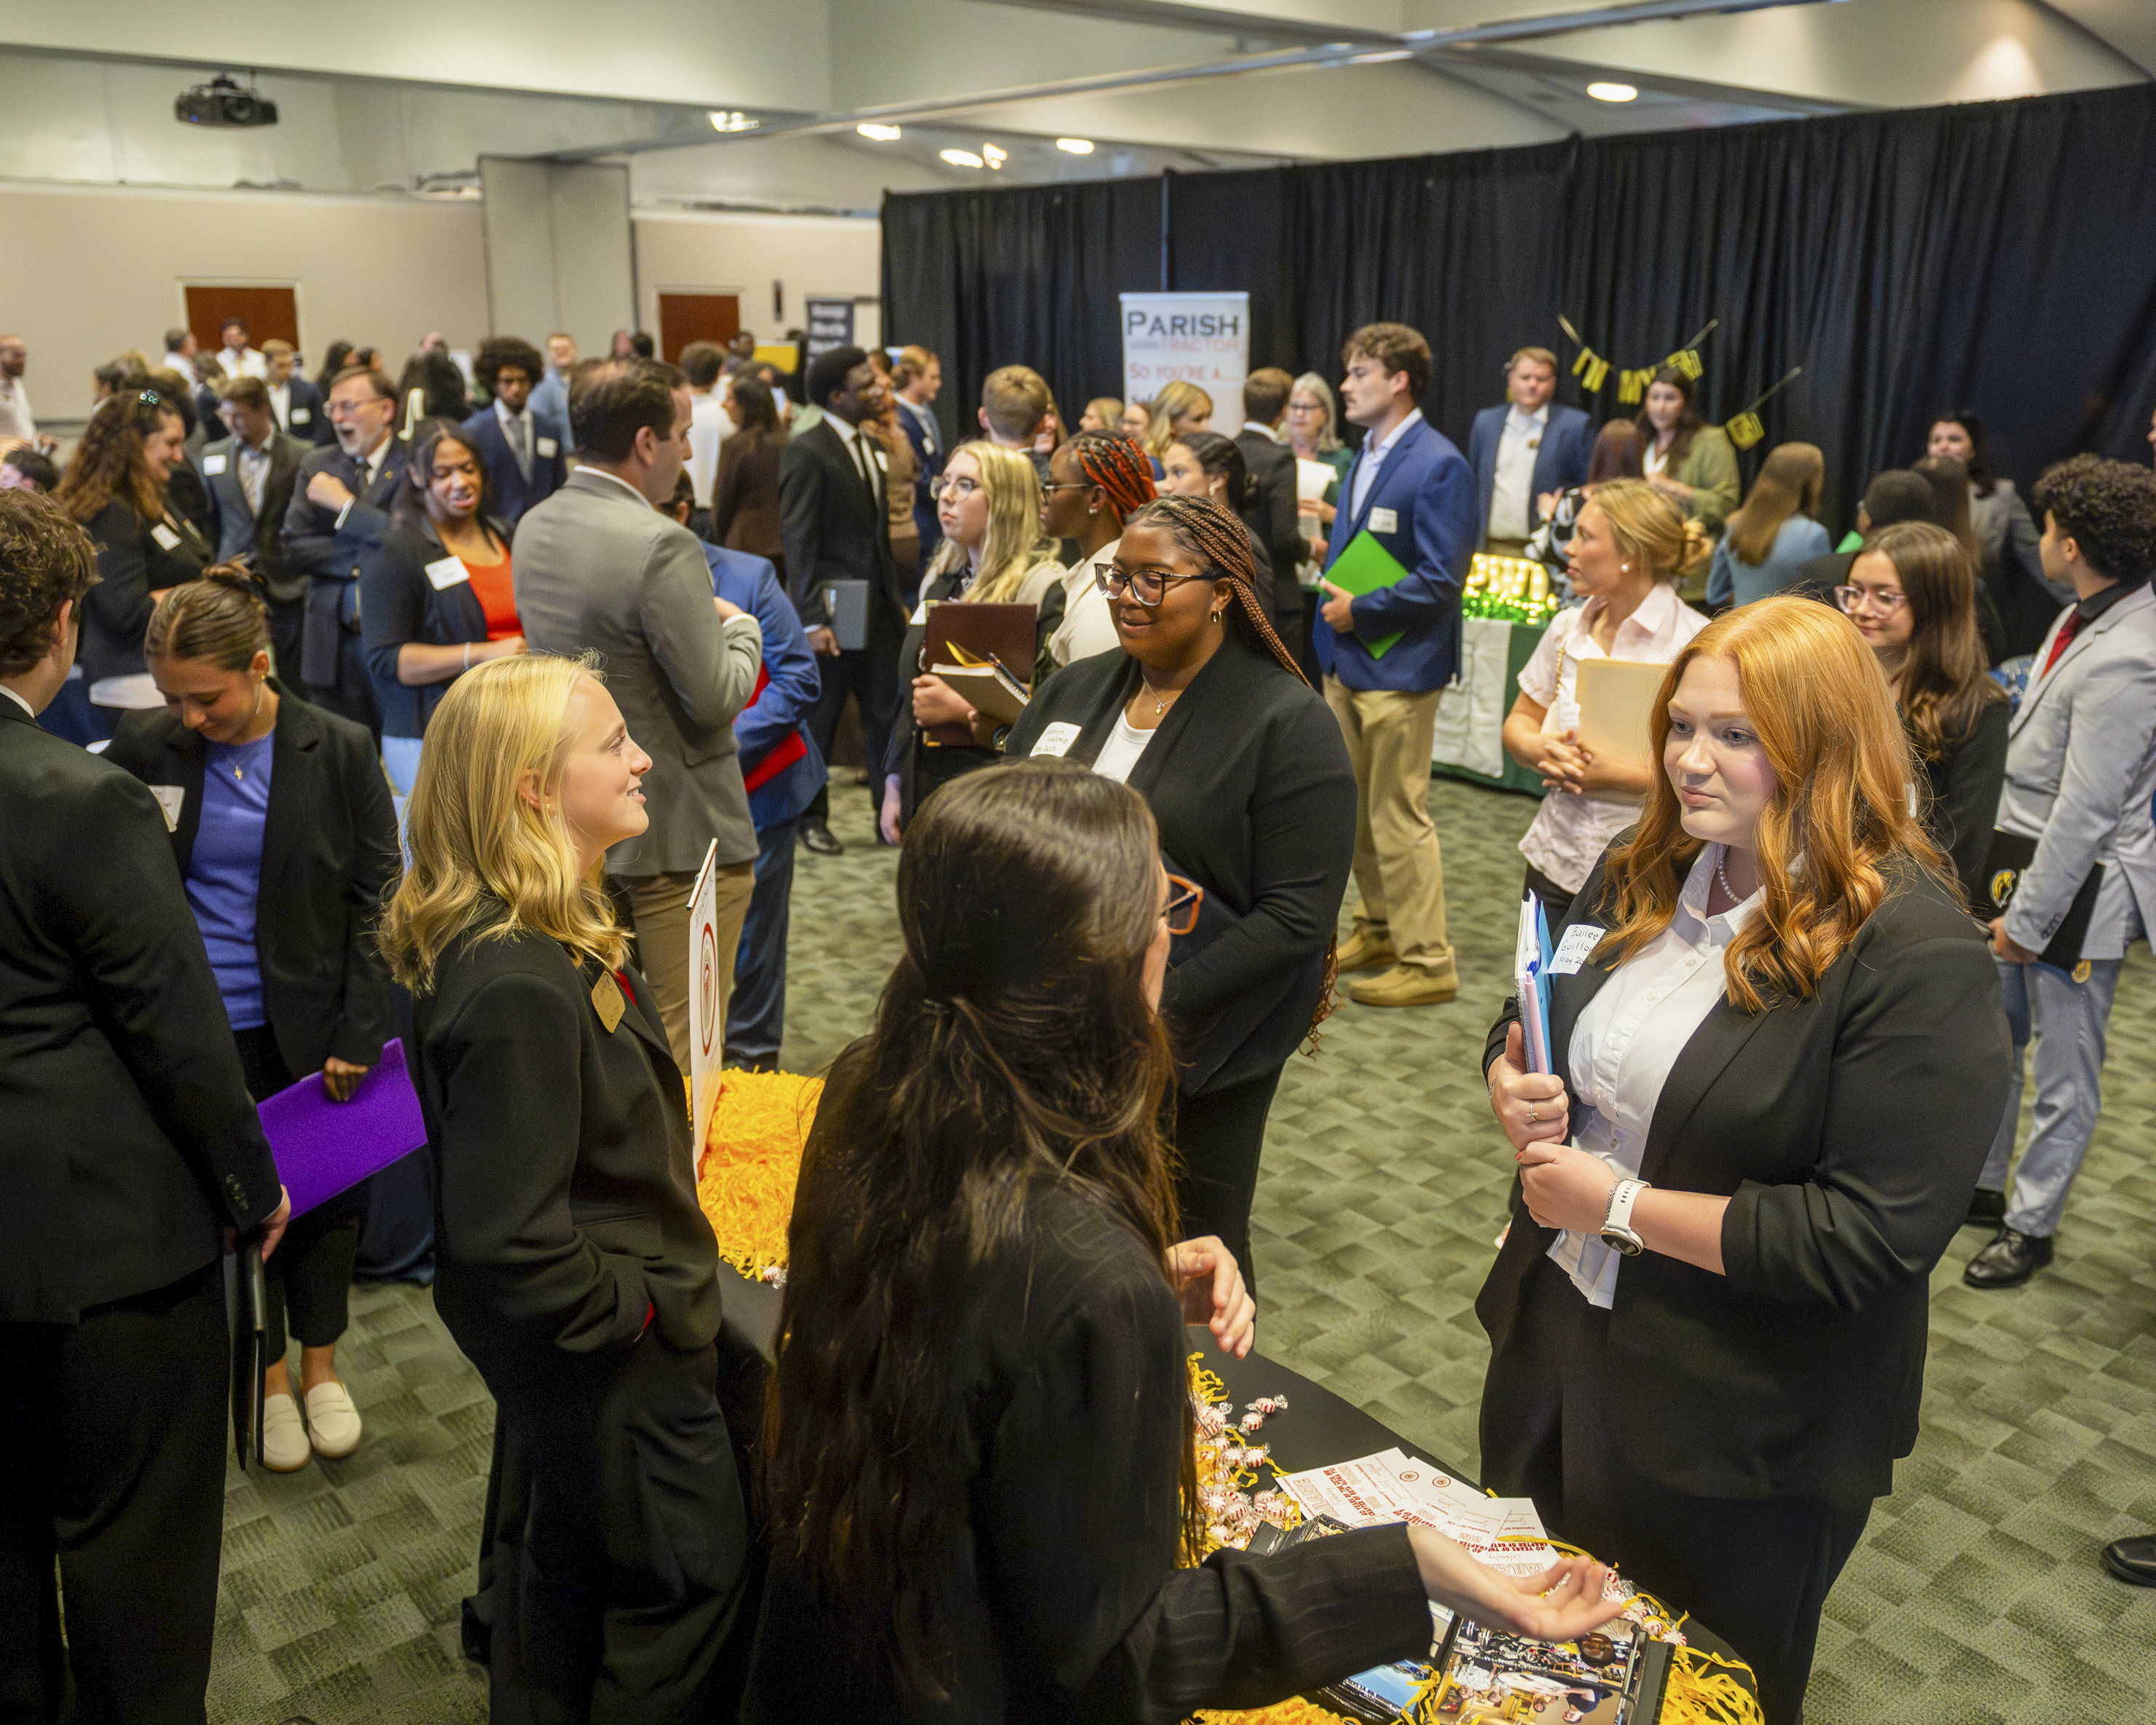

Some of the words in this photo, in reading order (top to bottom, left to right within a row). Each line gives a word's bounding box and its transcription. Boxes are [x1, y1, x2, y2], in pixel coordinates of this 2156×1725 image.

[1128, 311, 1238, 336] PARISH
[1570, 926, 1599, 940] Bailee
[1559, 956, 1573, 965] May
[1334, 1474, 1348, 1485] ALPHA
[1345, 1486, 1356, 1495] BETA
[1348, 1498, 1359, 1510] YEARS
[1358, 1501, 1376, 1516] CHAPTER
[1412, 1515, 1436, 1528] CHAPTER
